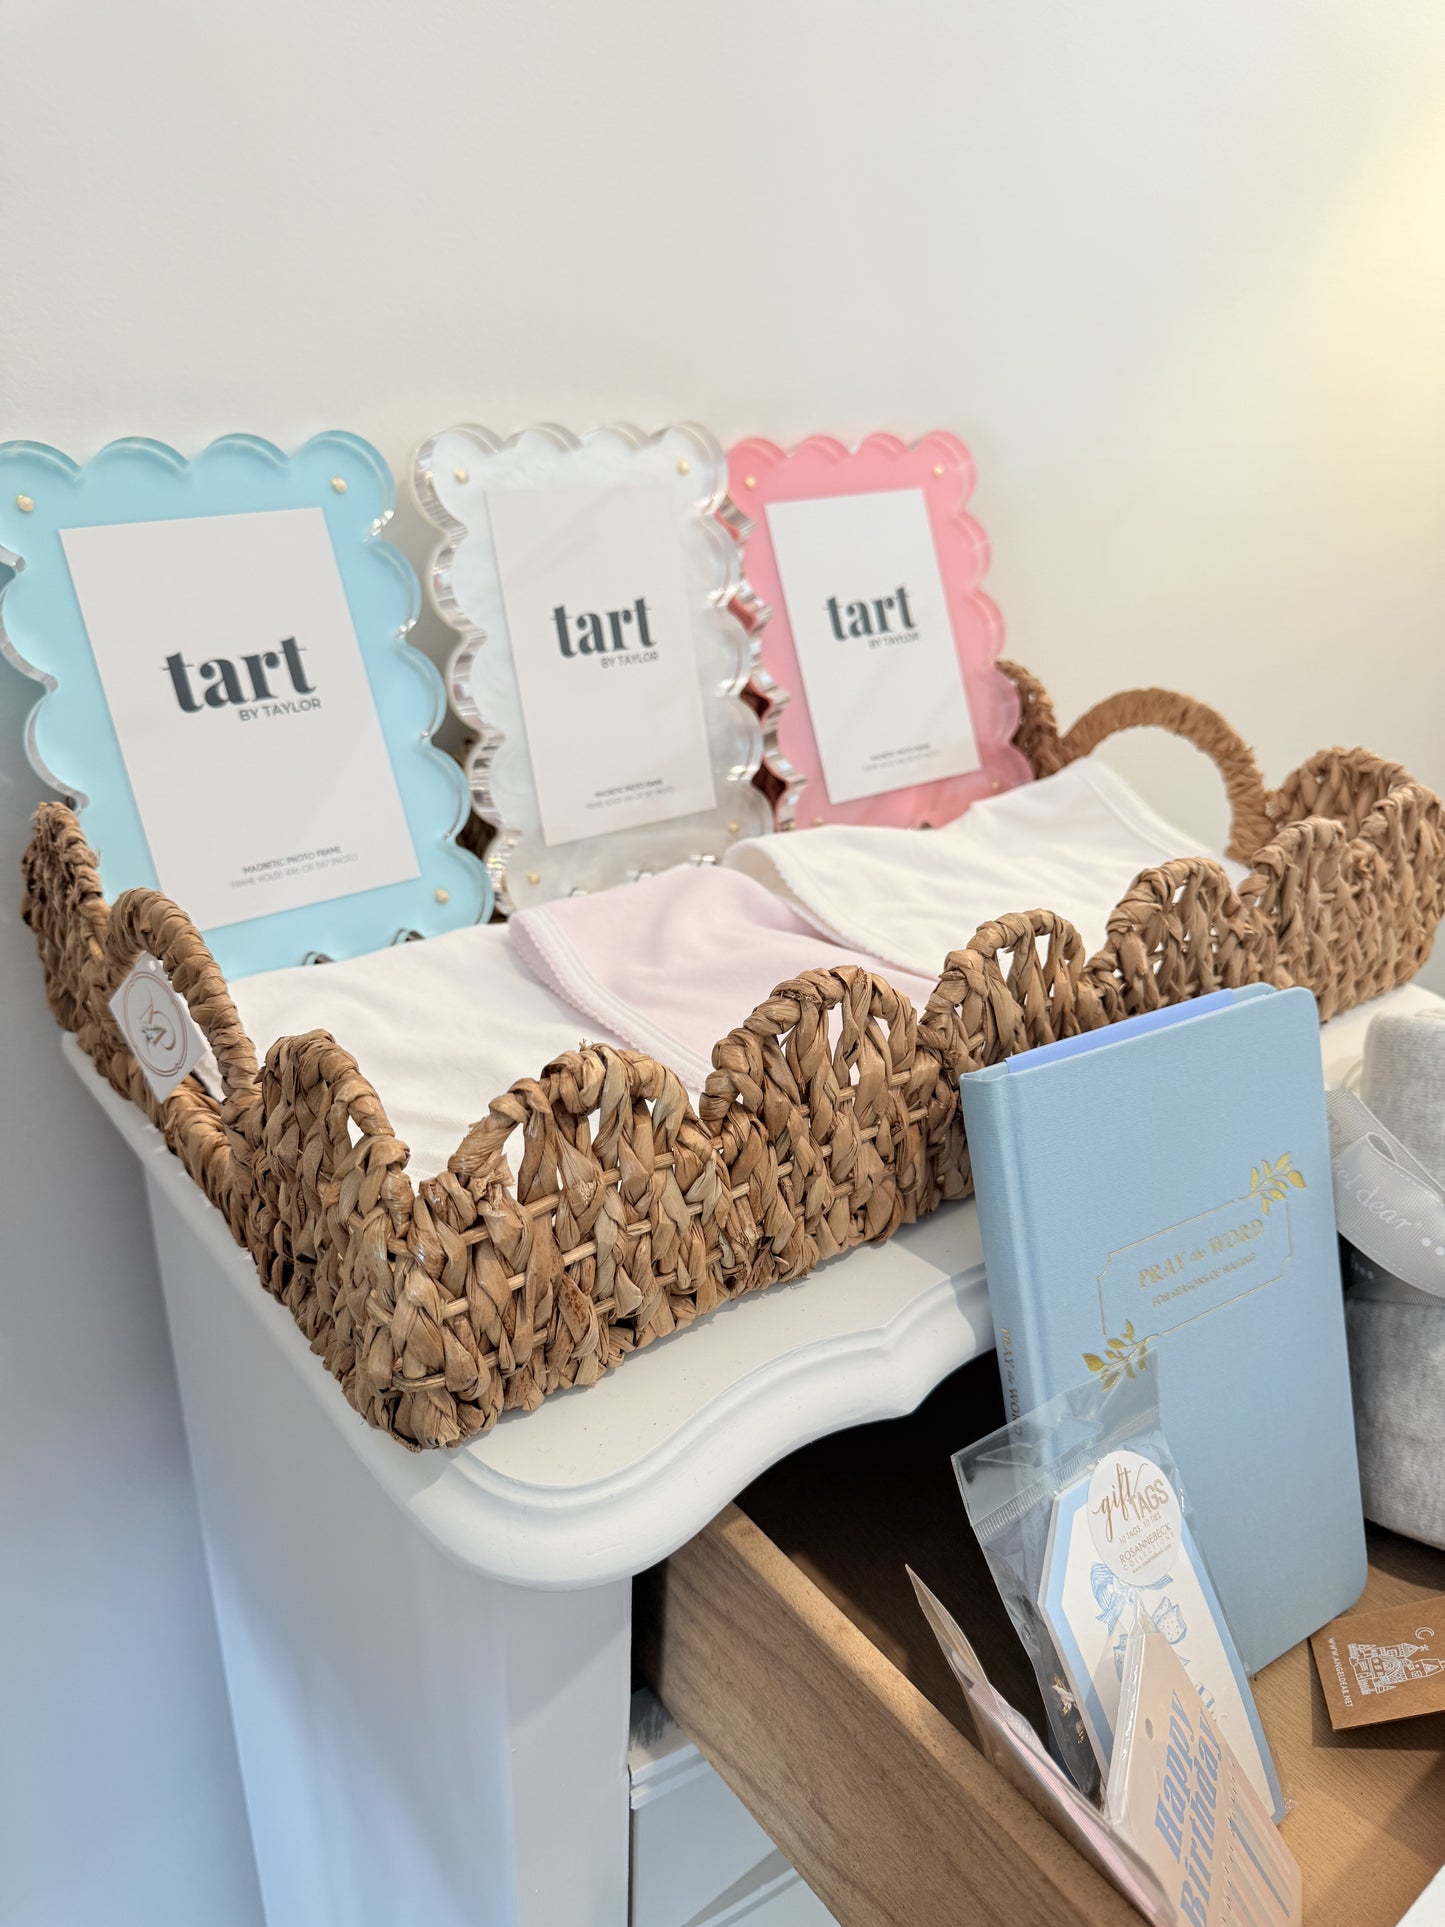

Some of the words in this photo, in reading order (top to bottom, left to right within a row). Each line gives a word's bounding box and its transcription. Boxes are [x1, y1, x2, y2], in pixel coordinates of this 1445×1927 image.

[551, 597, 657, 659] tart
[823, 586, 917, 642] tart
[162, 636, 317, 713] tart
[601, 656, 615, 669] BY
[617, 650, 659, 666] TAYLOR
[239, 708, 261, 722] BY
[262, 698, 322, 718] TAYLOR
[1356, 1186, 1413, 1230] dear
[1138, 1250, 1186, 1289] PRAY
[1208, 1218, 1264, 1255] WORD
[1152, 1291, 1170, 1307] FOR
[1092, 1463, 1147, 1543] gift
[1127, 1479, 1169, 1520] TAGS
[1119, 1523, 1172, 1565] ROSANNEBECK
[1328, 1637, 1353, 1708] WWW.ANGELDEAR.NET
[1155, 1688, 1195, 1865] Happy
[1181, 1709, 1222, 1927] Birthday
